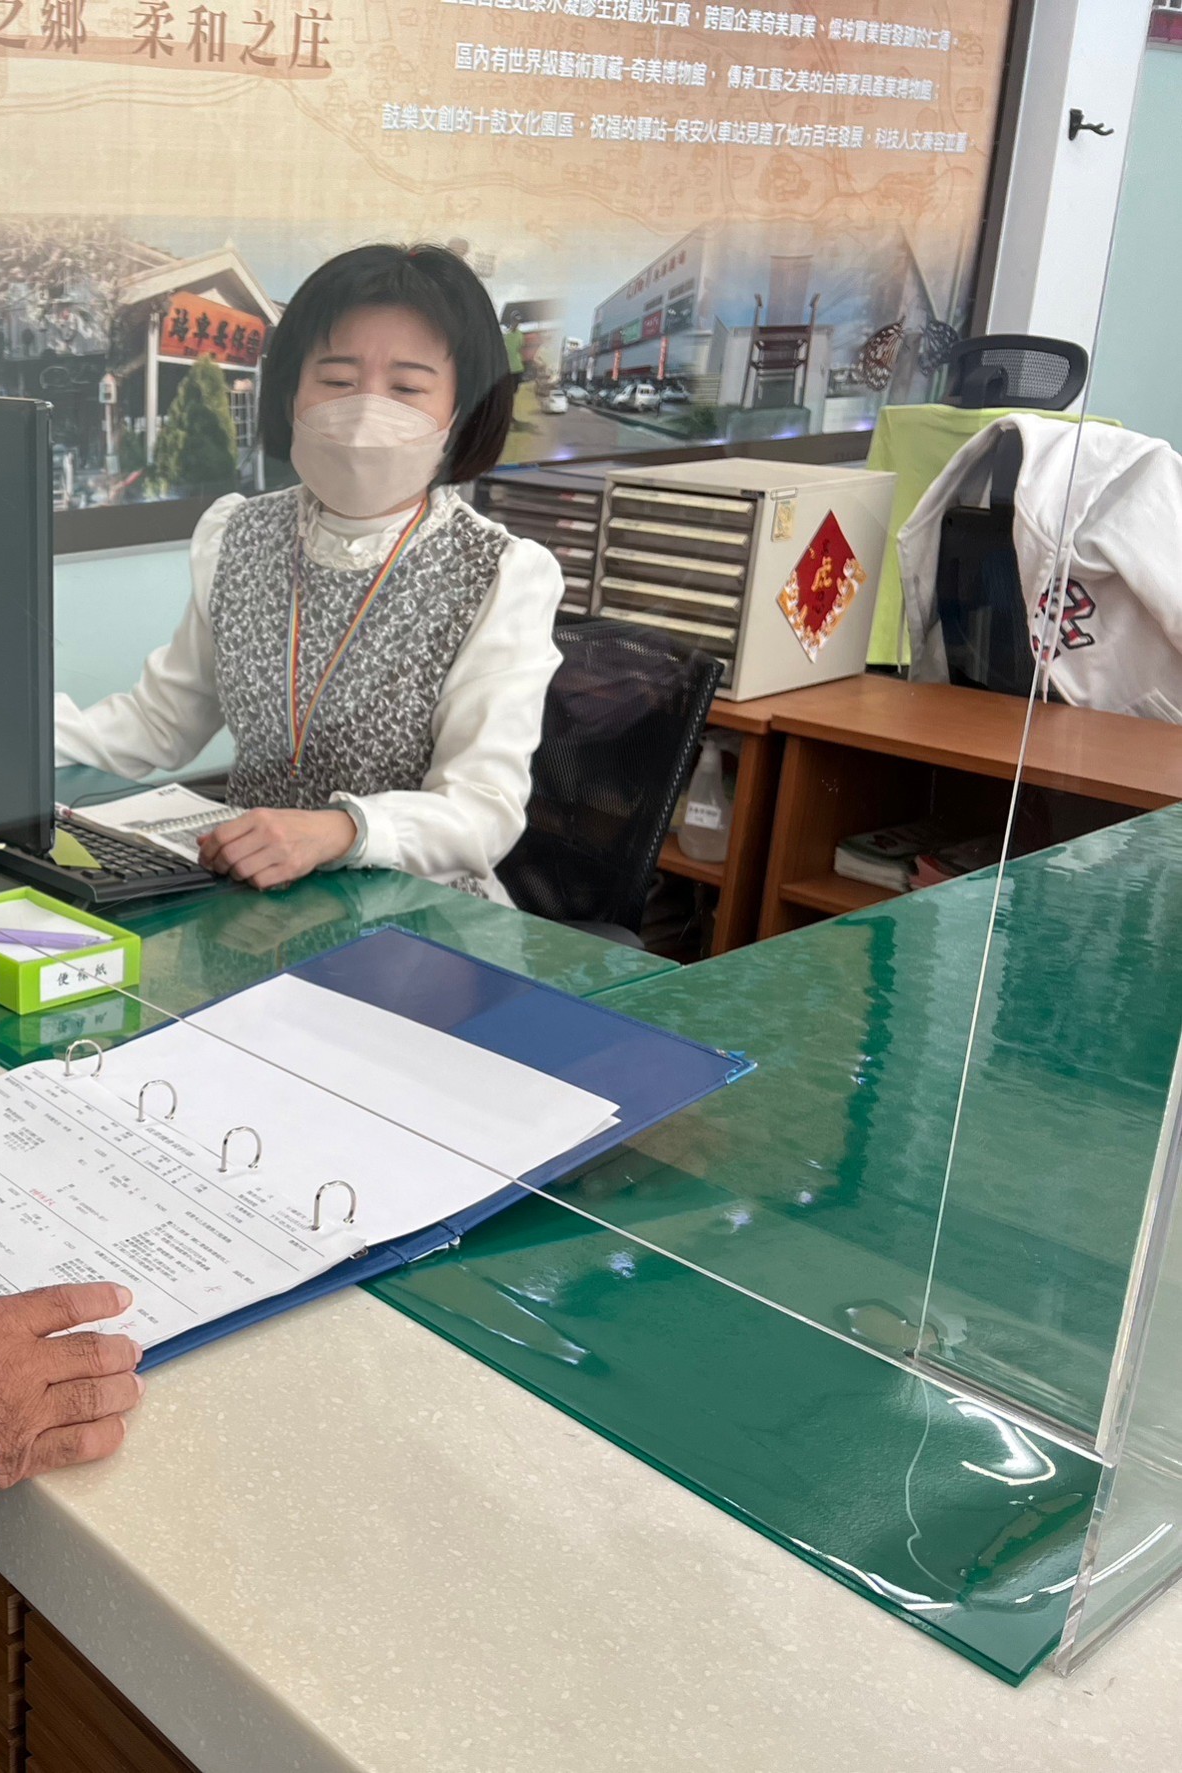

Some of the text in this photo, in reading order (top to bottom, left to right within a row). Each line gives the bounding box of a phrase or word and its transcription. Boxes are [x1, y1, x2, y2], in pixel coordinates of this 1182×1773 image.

[132, 1, 334, 70] 柔和之庄
[57, 962, 107, 986] 便條紙
